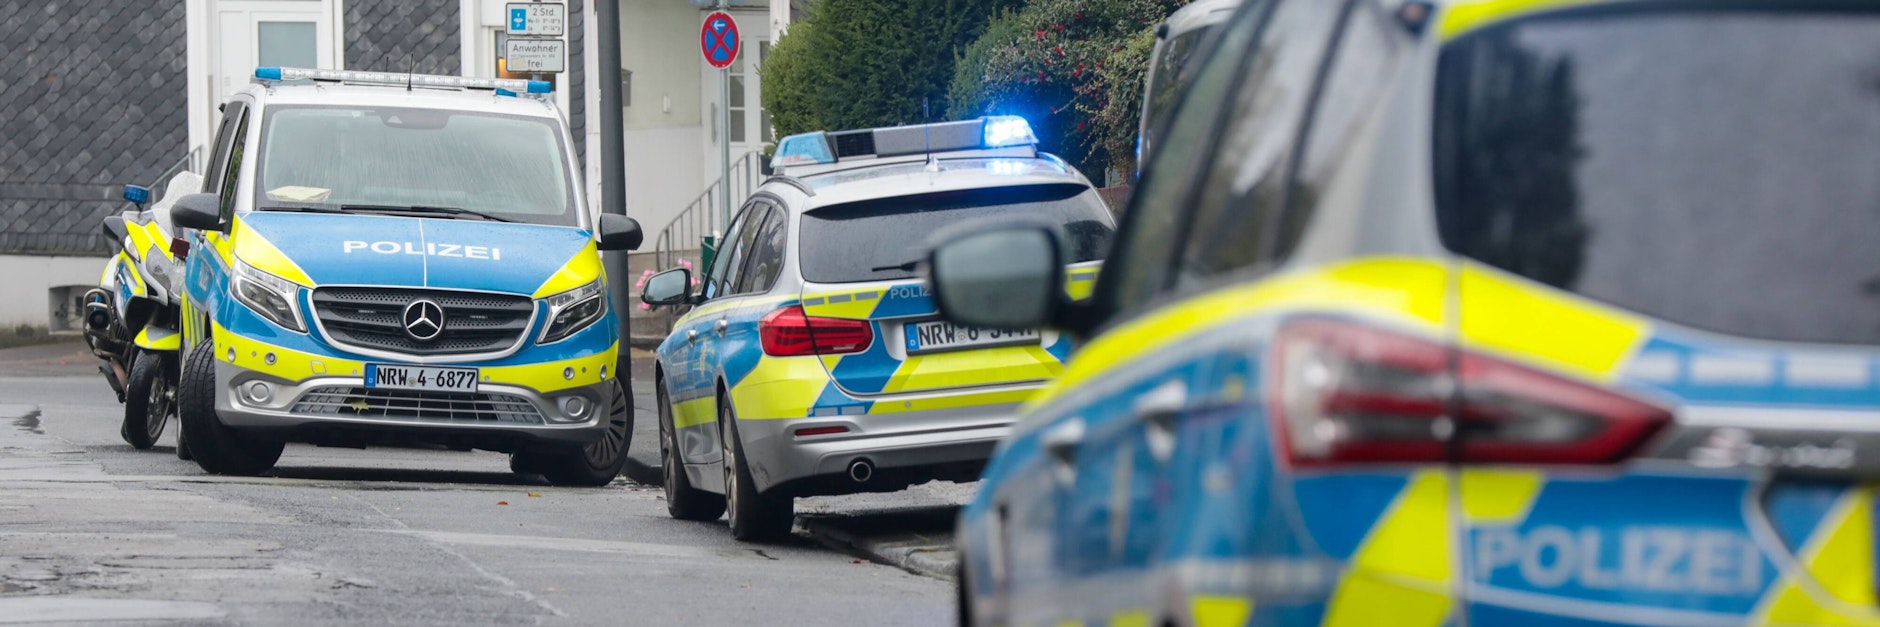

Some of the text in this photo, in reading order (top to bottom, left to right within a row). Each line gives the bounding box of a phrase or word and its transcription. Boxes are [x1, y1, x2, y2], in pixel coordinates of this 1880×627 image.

[532, 8, 538, 16] 2
[512, 43, 558, 53] Anwohner
[527, 59, 543, 68] frei
[343, 240, 501, 261] POLIZEI
[890, 284, 932, 300] POLIZ
[918, 323, 955, 347] NRW
[376, 367, 408, 387] NRW
[1474, 525, 1764, 594] POLIZEI
